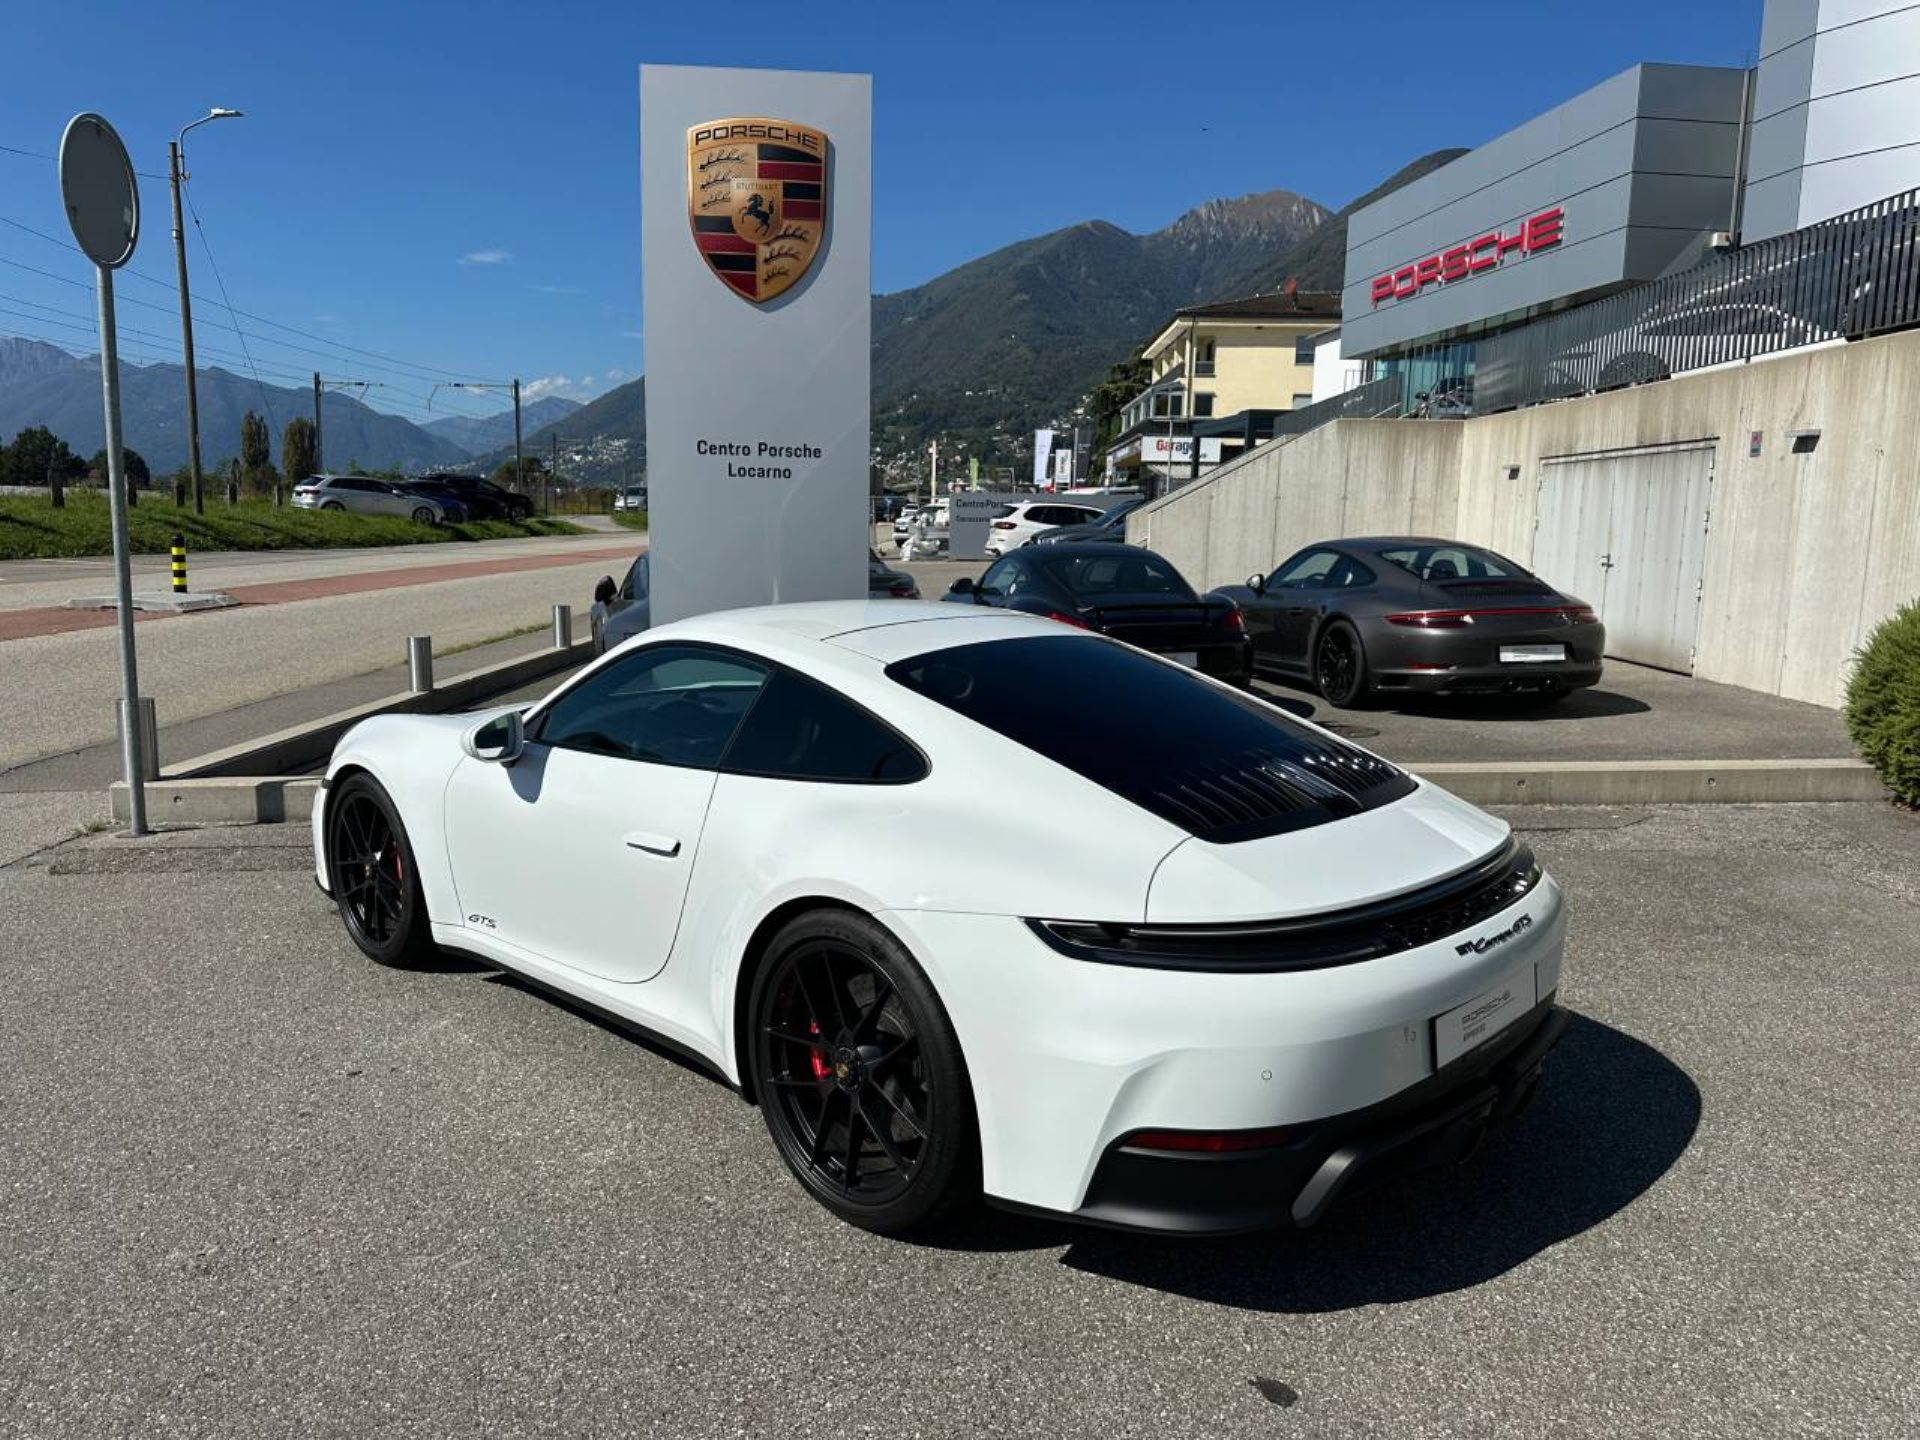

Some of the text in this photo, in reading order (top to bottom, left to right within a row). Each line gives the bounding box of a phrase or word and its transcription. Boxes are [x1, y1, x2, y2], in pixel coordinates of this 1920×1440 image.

[695, 124, 819, 151] PORSCHE
[1371, 206, 1565, 309] PORSCHE
[696, 439, 822, 458] Centro Porsche
[728, 461, 792, 479] Locarno
[468, 914, 496, 928] GTS
[1512, 913, 1533, 934] GTS
[1462, 989, 1512, 1024] PORSCHE
